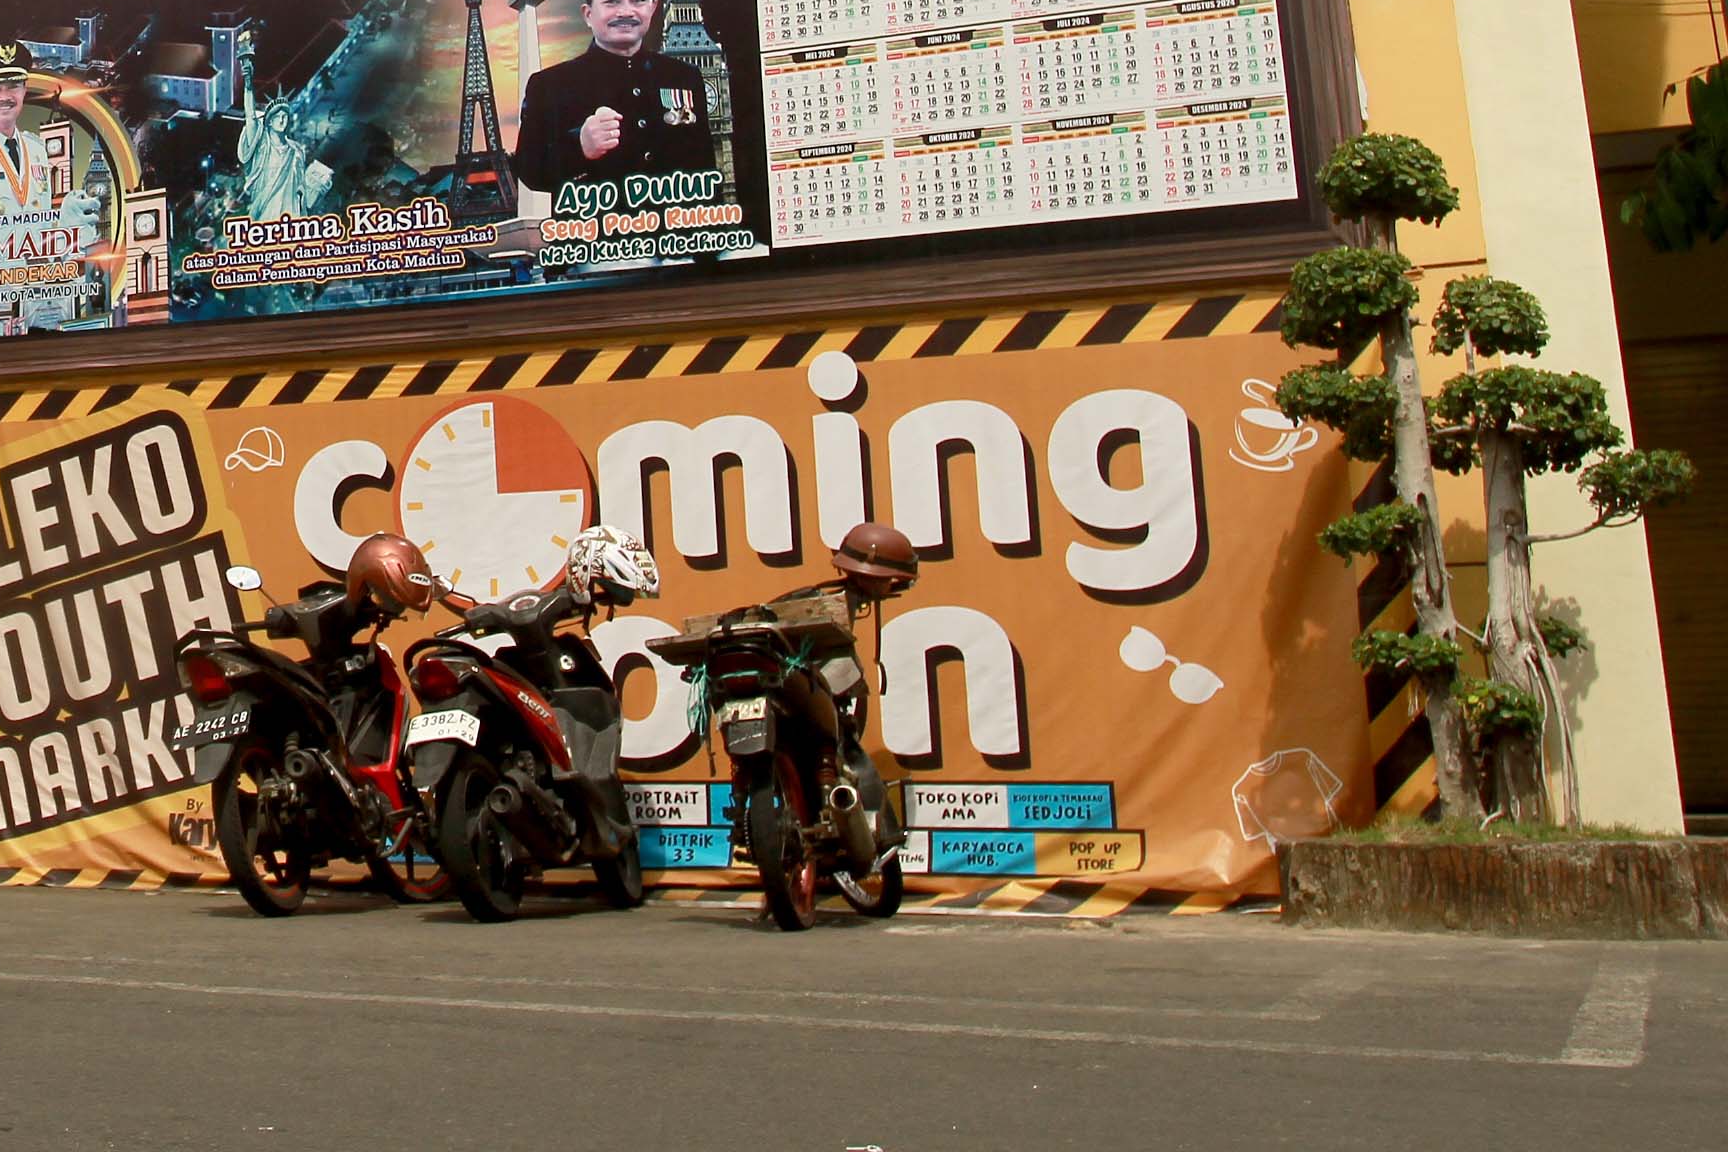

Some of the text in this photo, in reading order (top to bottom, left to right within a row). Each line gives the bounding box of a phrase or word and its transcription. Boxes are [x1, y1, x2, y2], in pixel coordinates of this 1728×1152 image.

[555, 170, 723, 218] Ayo Dulur
[12, 210, 61, 225] MADIUN
[226, 200, 448, 248] Terima Kasih
[540, 204, 742, 242] Seng Podo Rukun
[185, 228, 494, 271] atas Dukungan dan Partisipasi Masyarakat
[540, 231, 754, 266] Nata Kutha Medhioen
[215, 252, 461, 287] dalam Pembangunan Kota Madiun
[0, 287, 36, 304] KOTA
[41, 282, 100, 299] MADIUN
[173, 711, 248, 740] AE 2242 CB
[421, 713, 457, 728] 3382
[186, 798, 204, 813] By
[916, 791, 957, 805] TOKO
[635, 806, 683, 820] ROOM
[941, 808, 977, 820] AMA
[942, 841, 1025, 854] KARYALOCA
[1069, 841, 1095, 855] POP
[674, 848, 695, 863] 33
[1077, 858, 1115, 870] STORE
